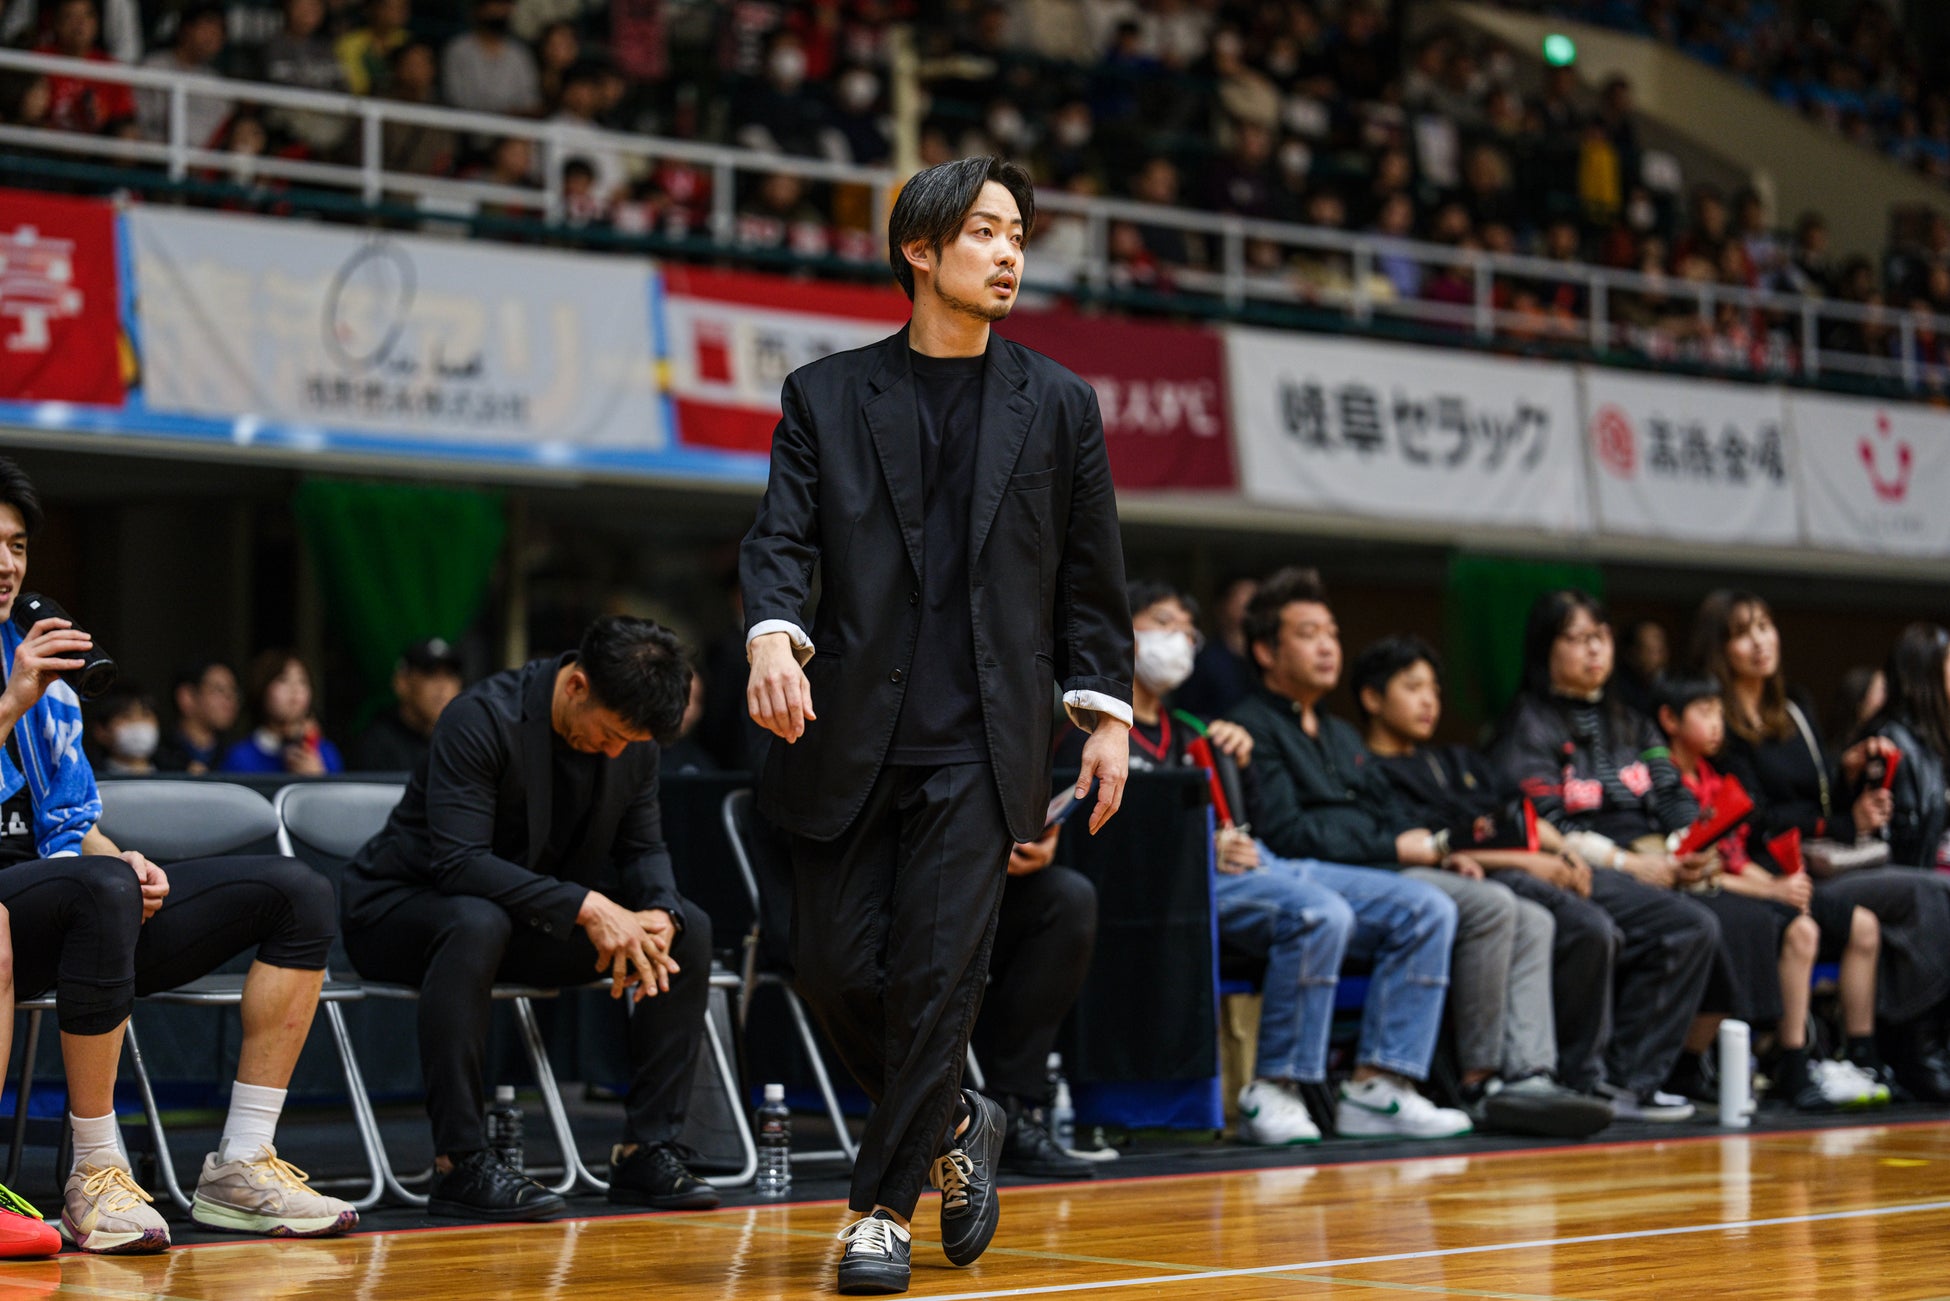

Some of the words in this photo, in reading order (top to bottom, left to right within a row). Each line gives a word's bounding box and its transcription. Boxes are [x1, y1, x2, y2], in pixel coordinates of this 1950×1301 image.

[1277, 380, 1550, 471] 岐阜セラック
